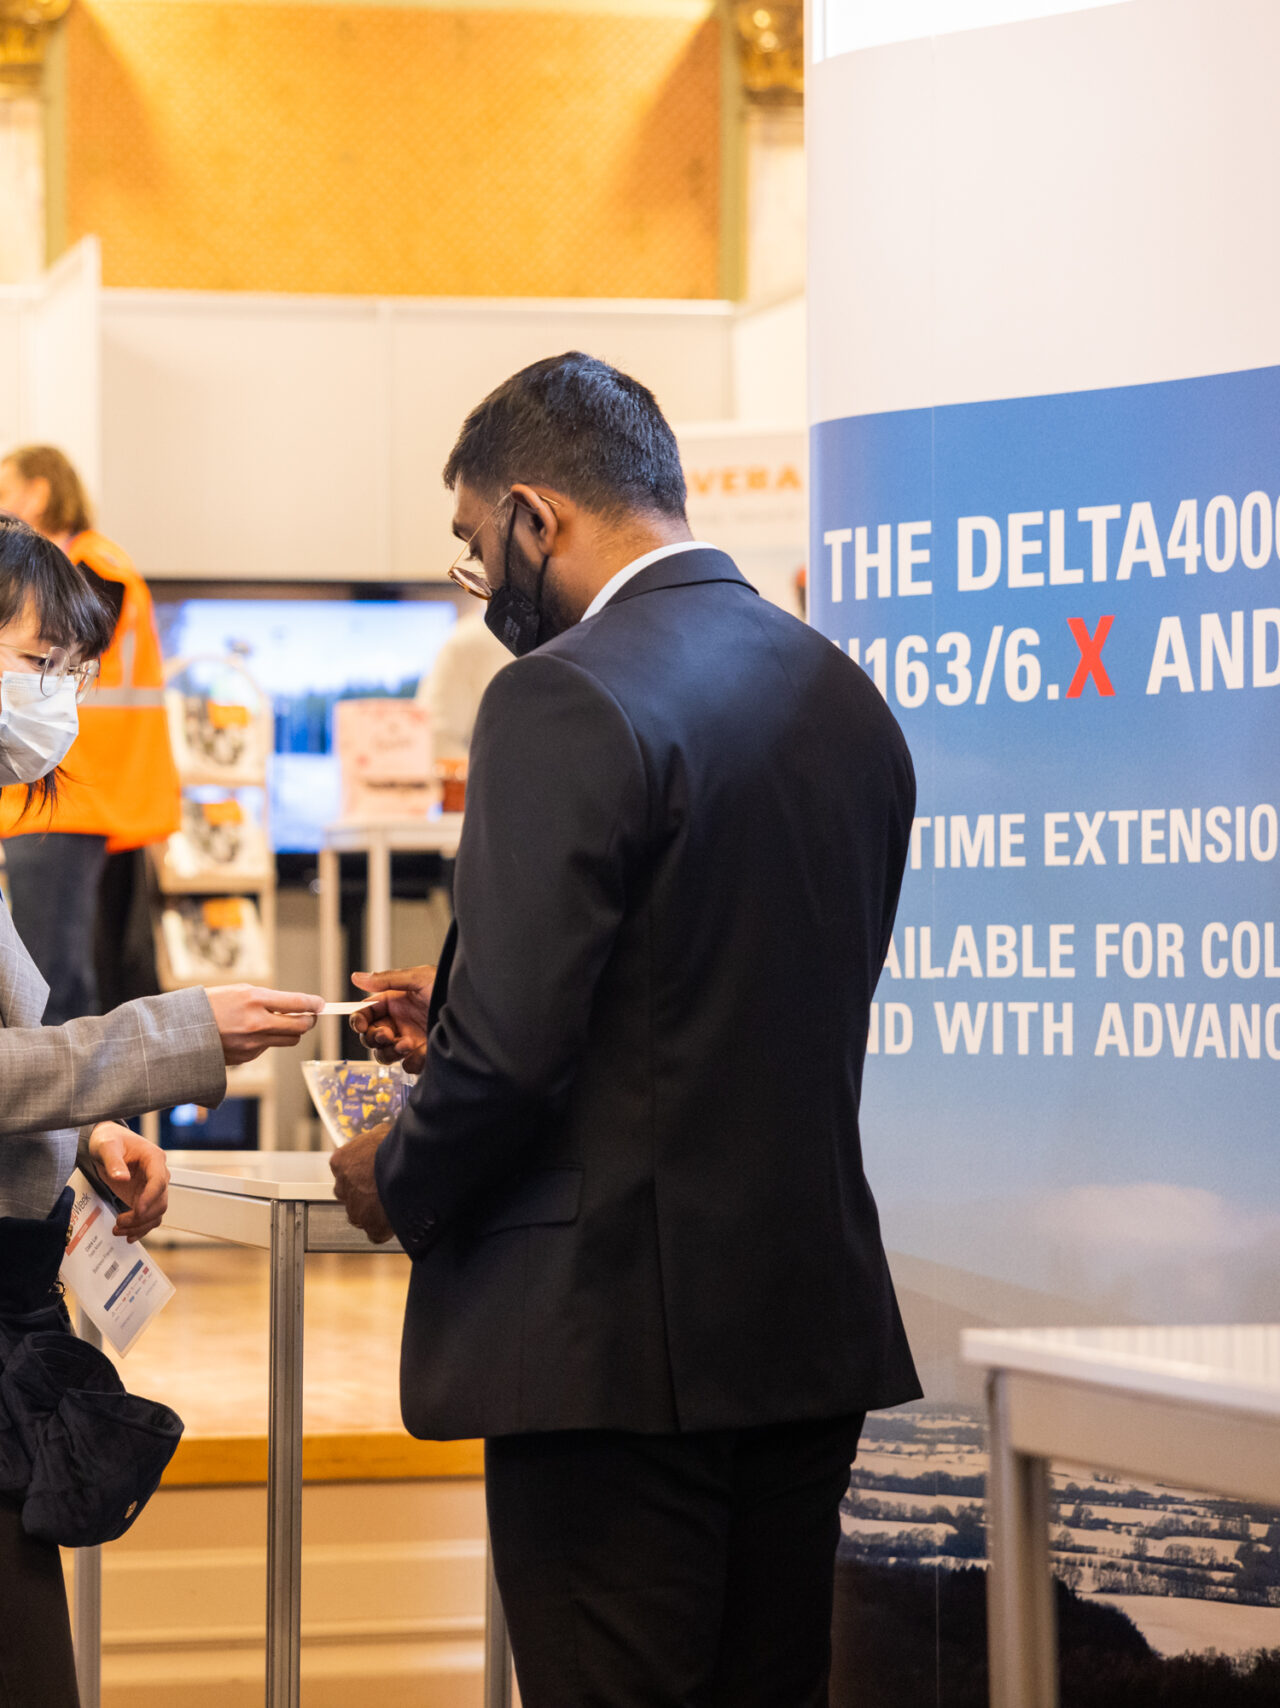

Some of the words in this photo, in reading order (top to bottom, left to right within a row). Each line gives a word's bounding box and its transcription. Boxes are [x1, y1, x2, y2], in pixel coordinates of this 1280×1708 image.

[824, 521, 932, 602] THE
[957, 490, 1280, 592] DELTA400
[1145, 607, 1280, 695] AND
[910, 813, 1026, 870] TIME
[1044, 804, 1279, 866] EXTENSIO
[1095, 922, 1185, 978] FOR
[1201, 921, 1280, 979] COL
[933, 1002, 1074, 1056] WITH
